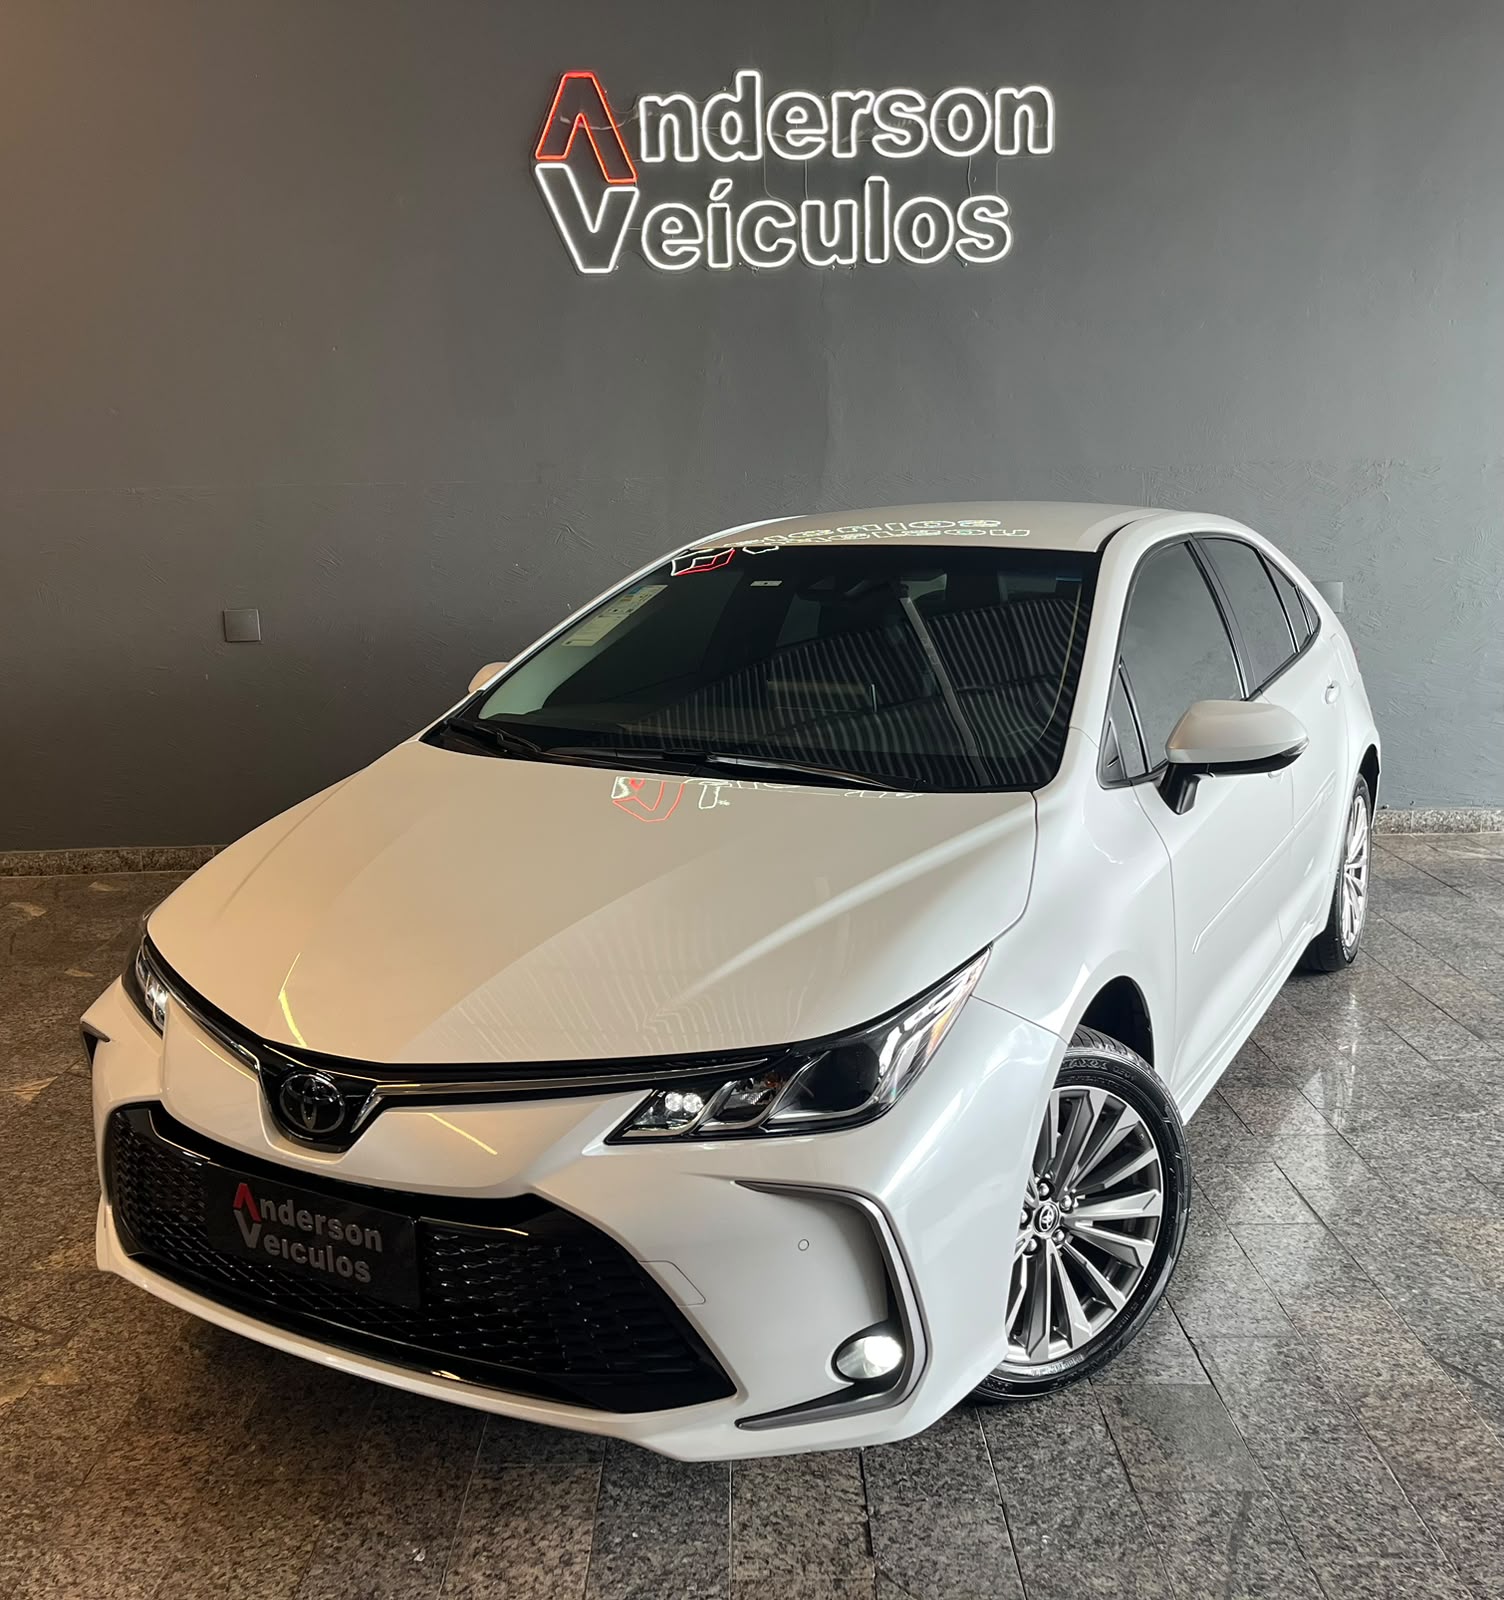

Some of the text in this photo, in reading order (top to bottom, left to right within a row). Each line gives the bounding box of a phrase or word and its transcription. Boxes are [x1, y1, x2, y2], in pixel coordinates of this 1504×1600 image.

[534, 69, 1055, 185] Anderson
[534, 162, 1013, 274] Veículos
[233, 1182, 384, 1252] Anderson
